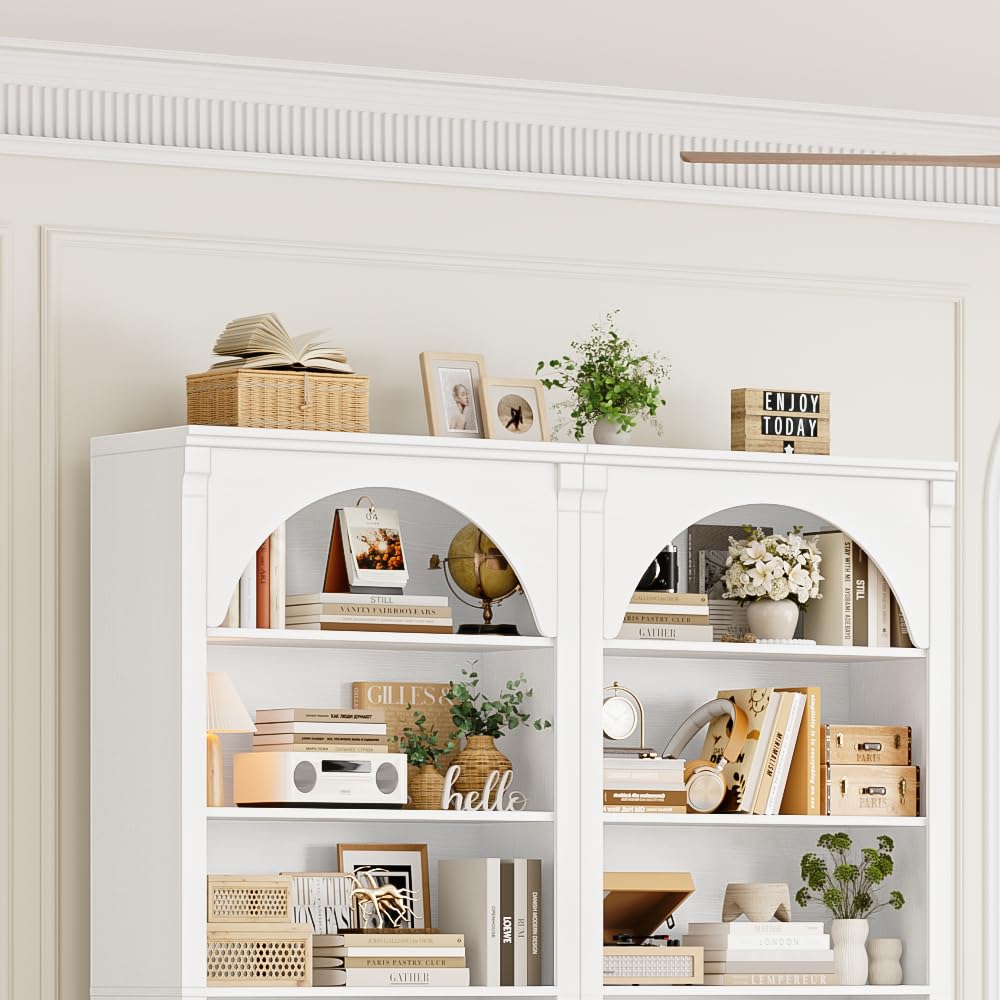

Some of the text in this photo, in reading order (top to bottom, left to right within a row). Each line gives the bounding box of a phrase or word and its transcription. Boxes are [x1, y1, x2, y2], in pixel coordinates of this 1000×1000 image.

[765, 392, 818, 412] ENJOY
[763, 417, 817, 436] TODAY
[365, 513, 378, 521] 04
[856, 579, 865, 601] STILL
[370, 596, 393, 604] STILL
[639, 628, 676, 638] GATHER
[367, 685, 436, 706] GILLES
[766, 731, 784, 777] MINIMALISM
[857, 754, 881, 762] PARIS
[441, 765, 528, 812] hello
[859, 798, 887, 809] PARIS
[503, 916, 512, 944] LOEWE
[759, 938, 799, 946] LONDON
[389, 972, 430, 983] GATHER
[751, 975, 827, 985] LEMPEREUR
